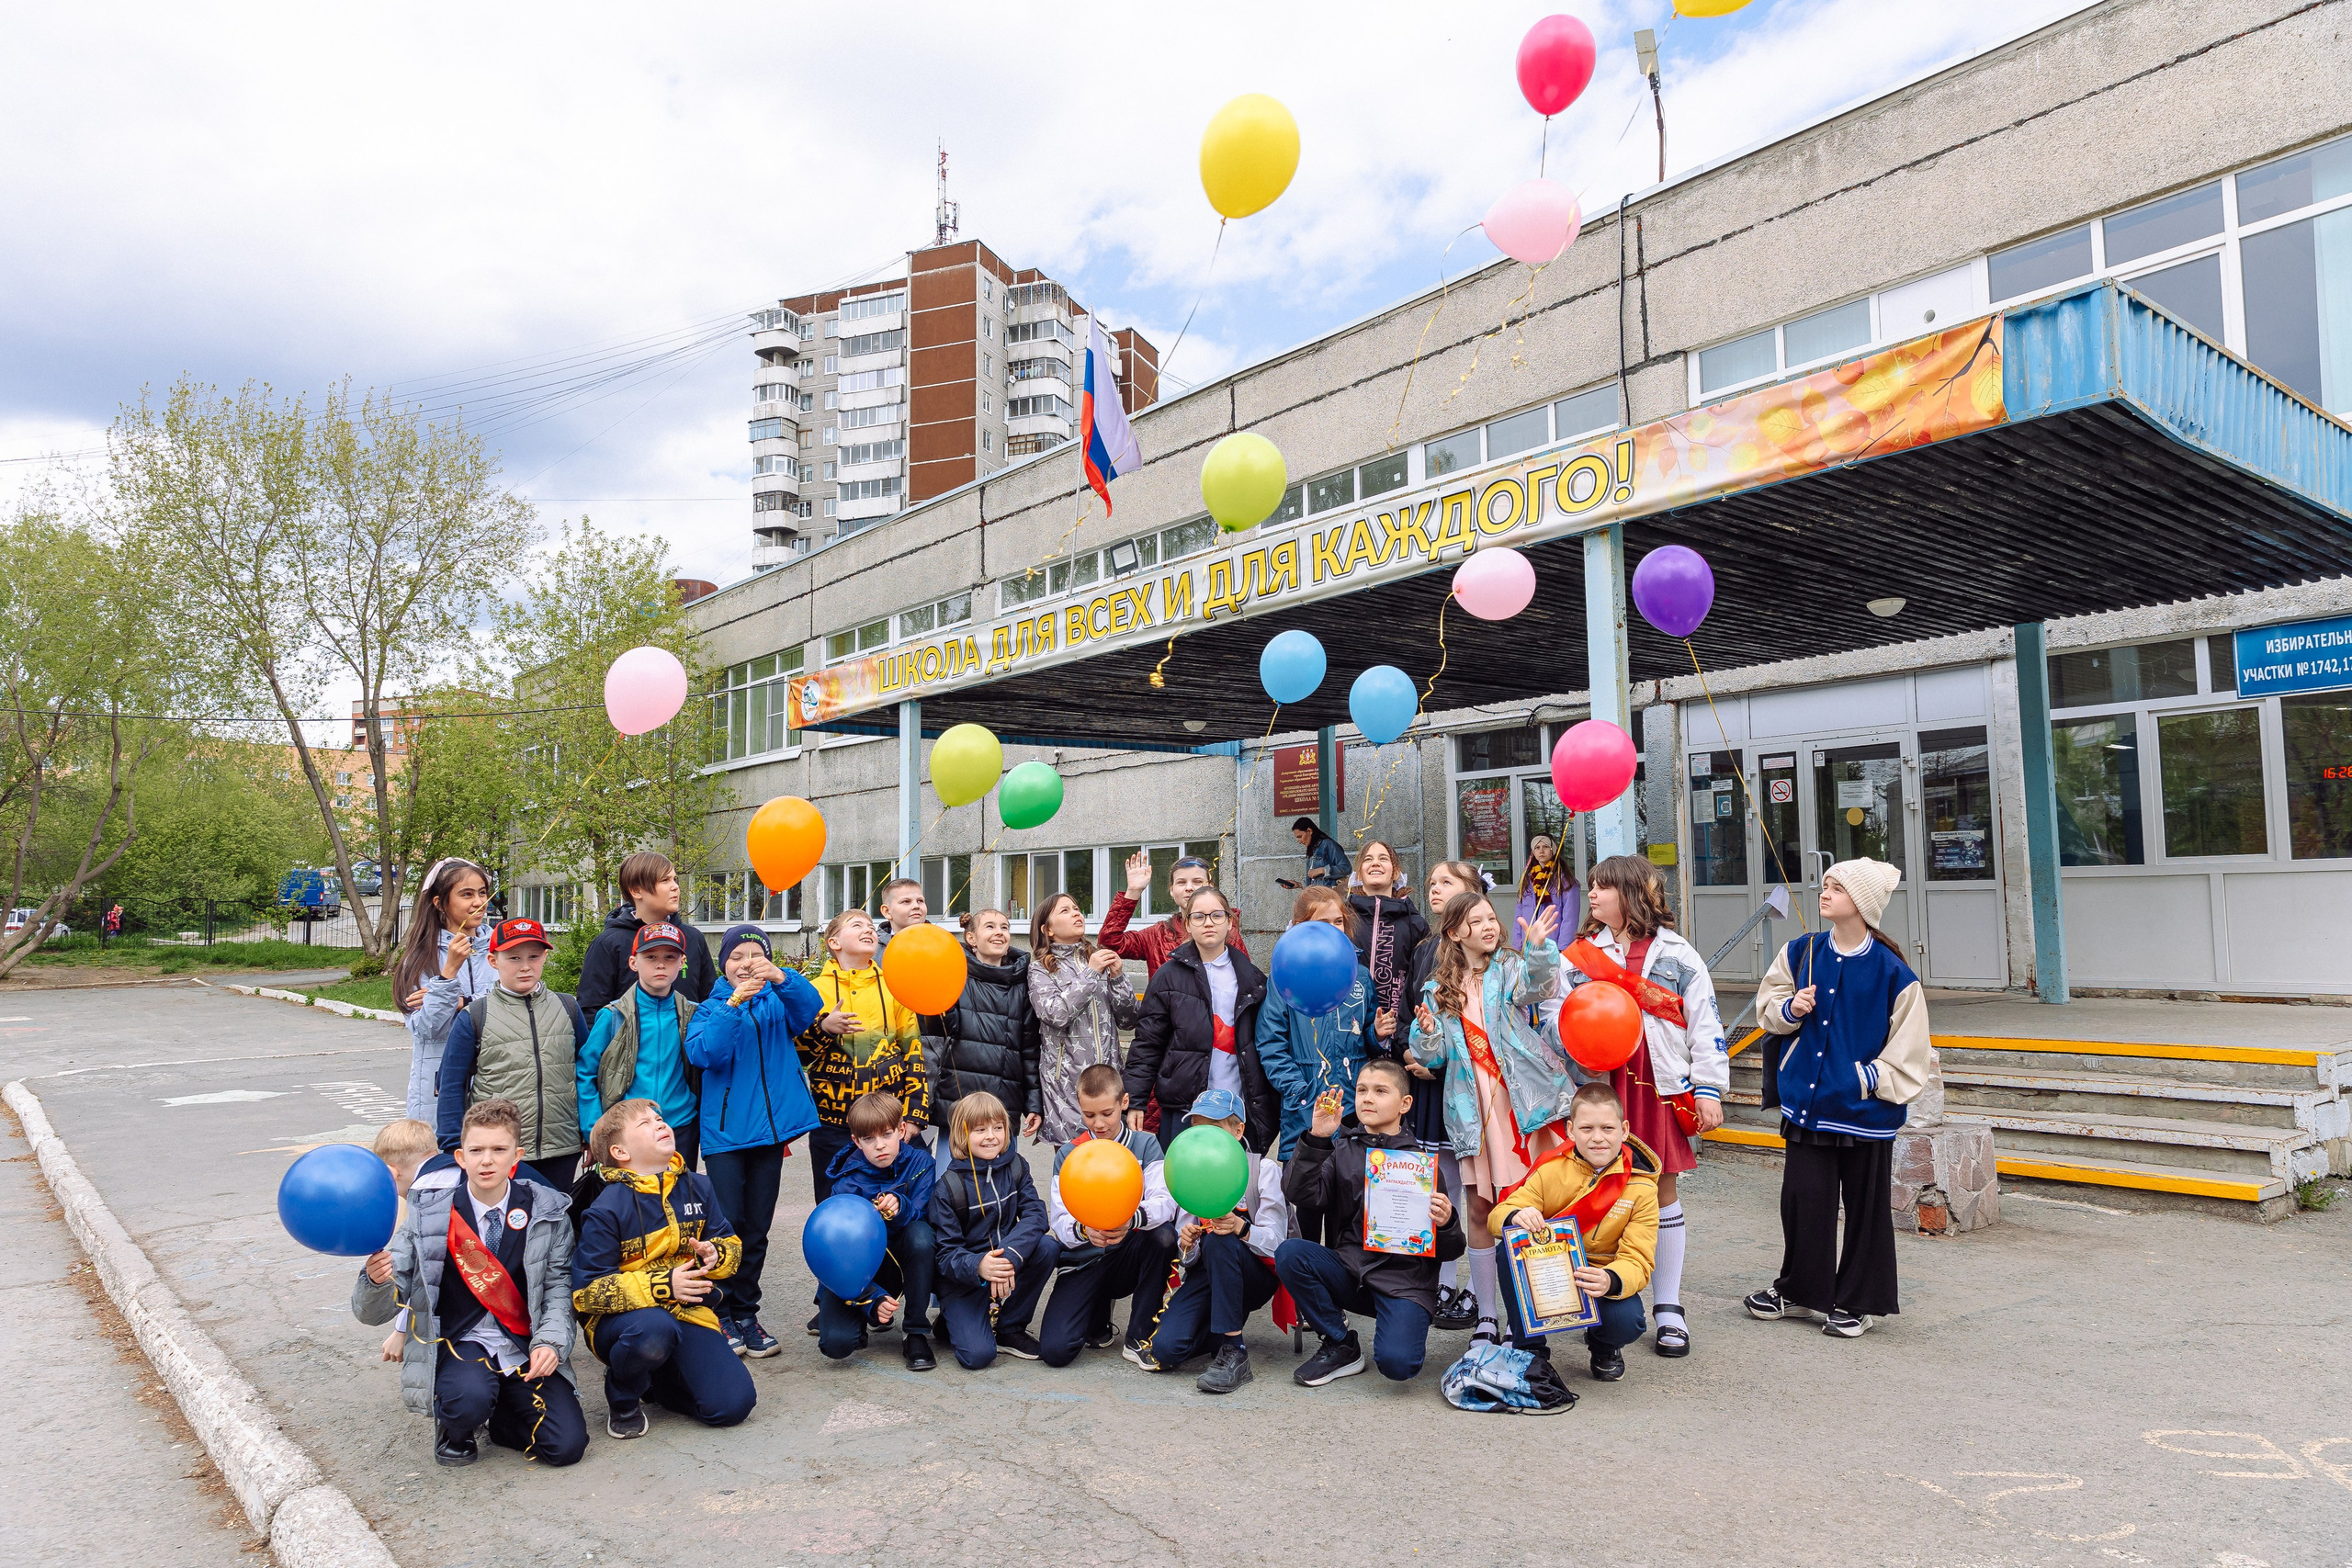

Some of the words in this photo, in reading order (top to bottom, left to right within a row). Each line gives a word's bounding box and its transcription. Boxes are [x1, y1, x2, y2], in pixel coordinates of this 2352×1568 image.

[876, 634, 981, 695] ШКОЛА
[985, 611, 1057, 676] ДЛЯ
[1065, 581, 1155, 648] ВСЕХ
[1163, 570, 1193, 623] И
[1201, 537, 1300, 623] ДЛЯ
[1311, 437, 1635, 584] КАЖДОГО!
[2243, 663, 2292, 682] УЧАСТКИ
[825, 1065, 853, 1076] BLAH
[1381, 1161, 1426, 1174] ГРАМОТА
[1528, 1245, 1563, 1256] ГРАМОТА
